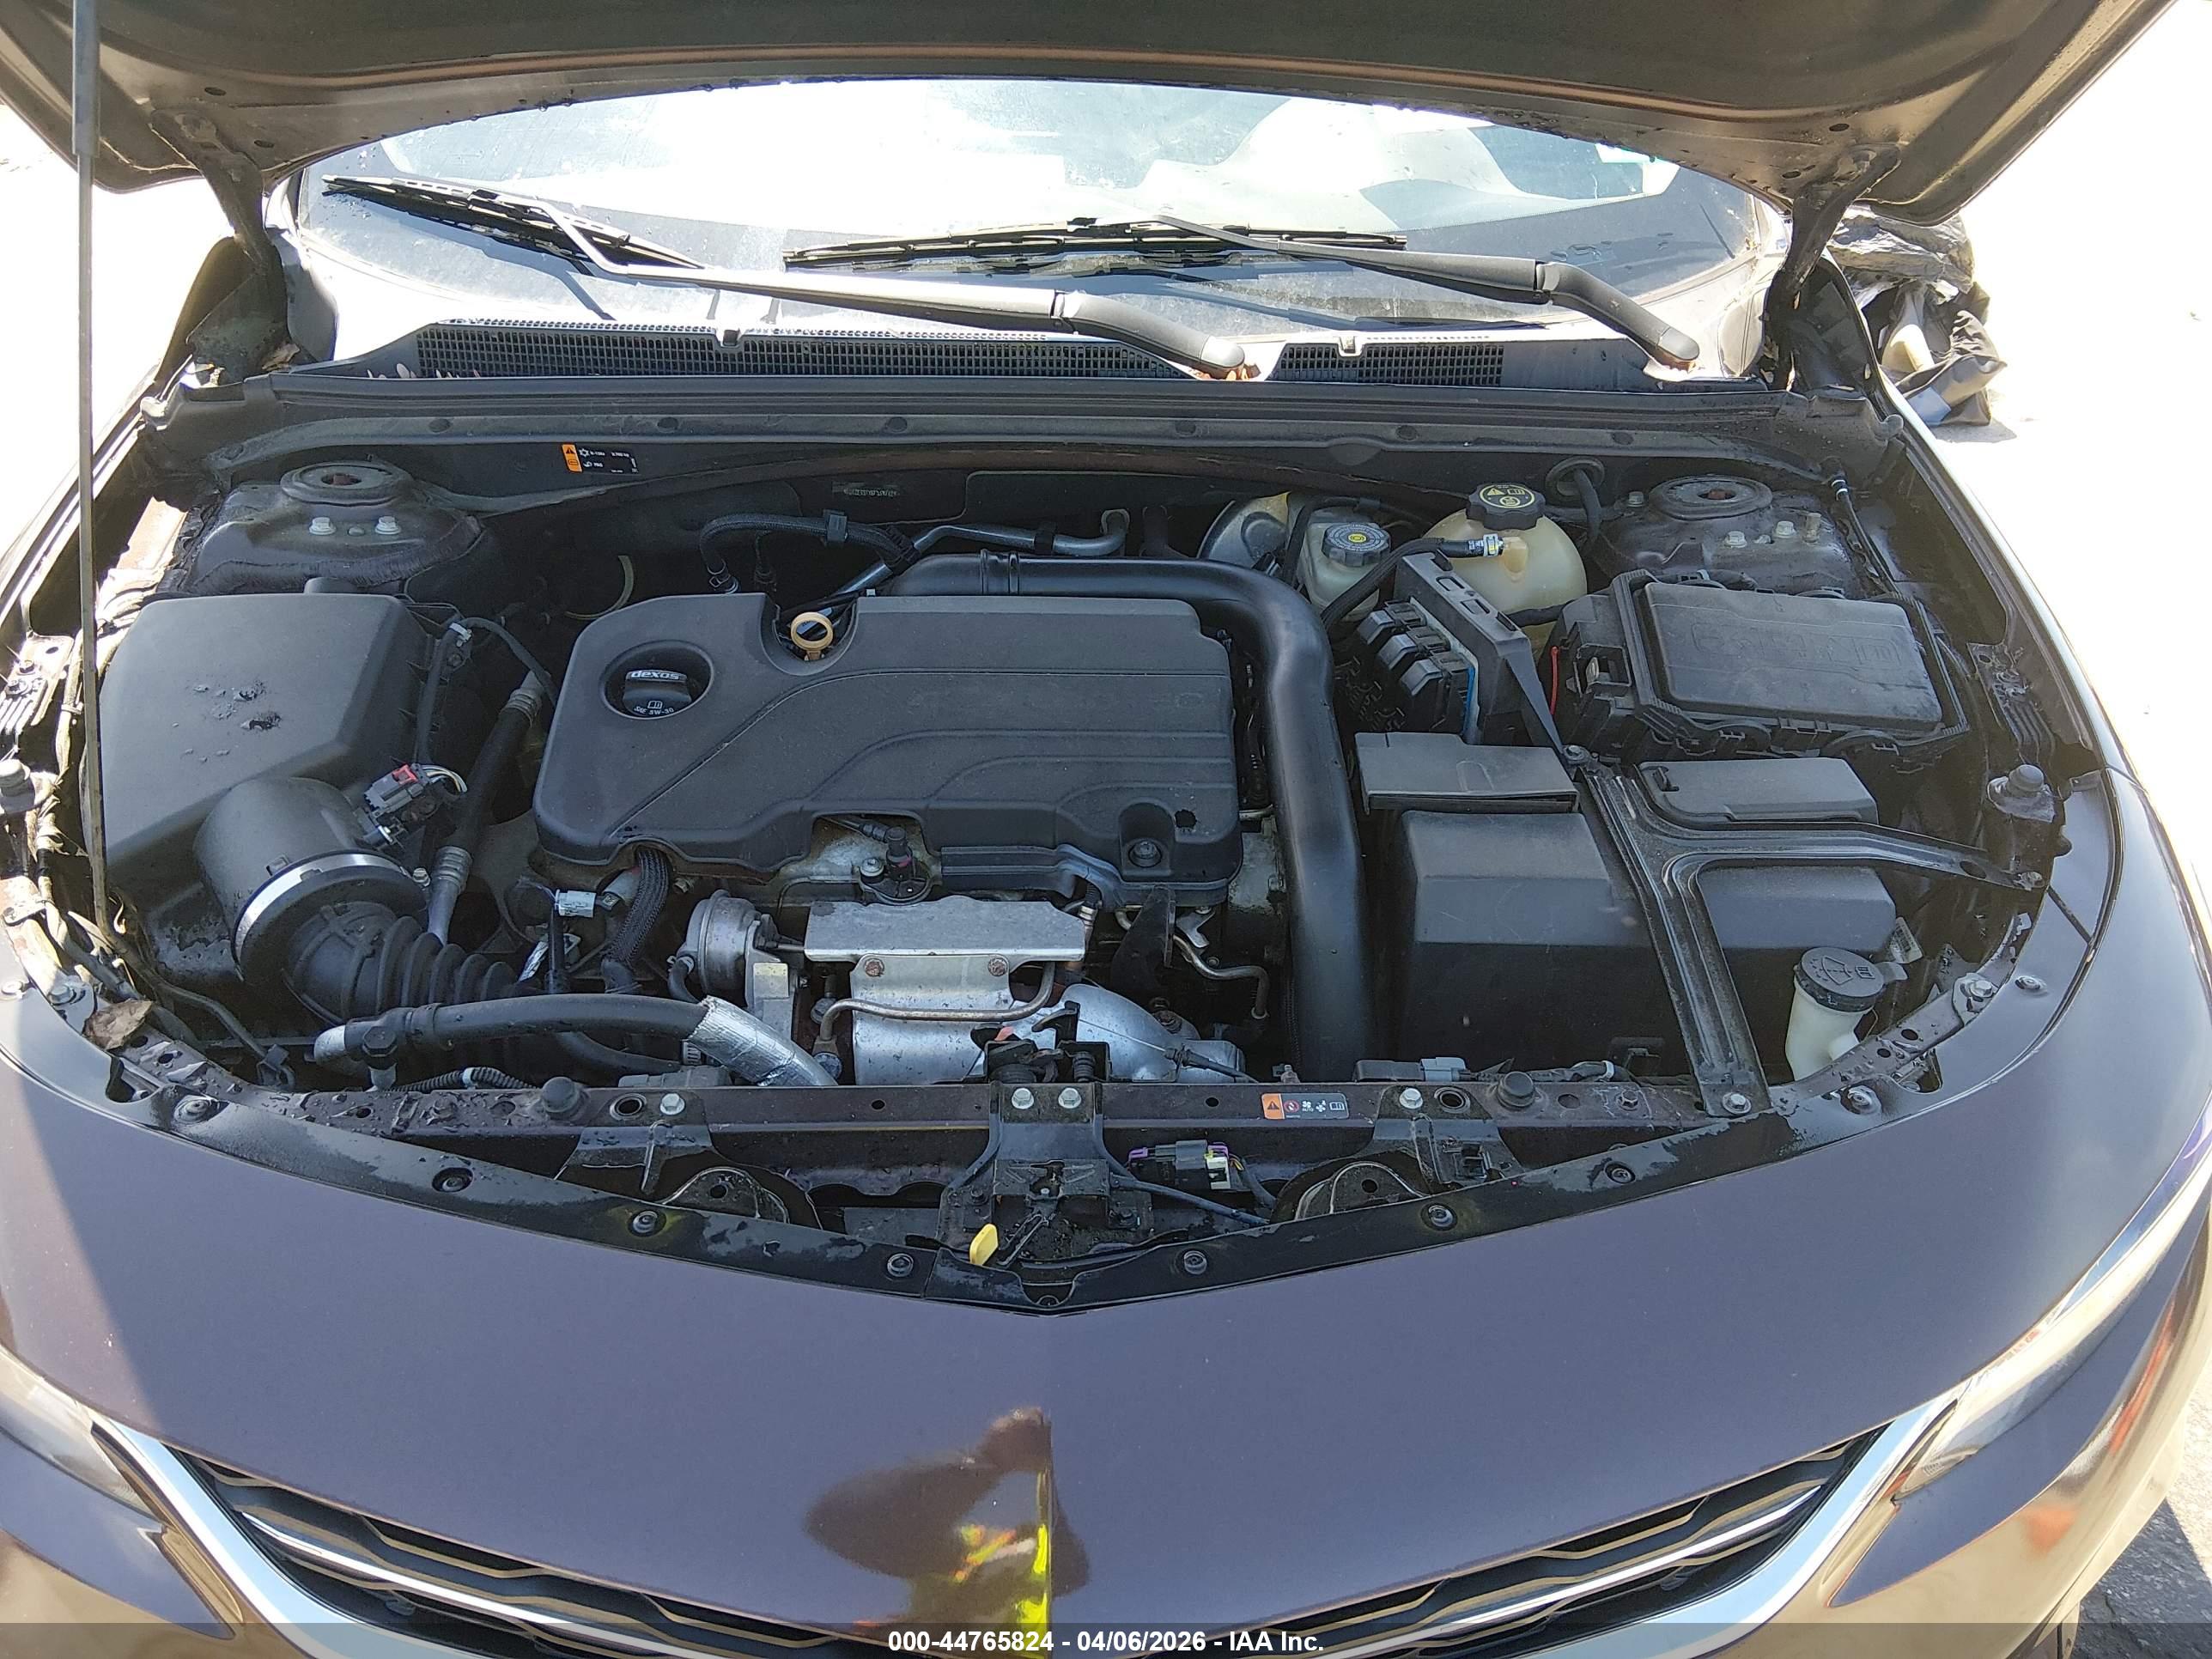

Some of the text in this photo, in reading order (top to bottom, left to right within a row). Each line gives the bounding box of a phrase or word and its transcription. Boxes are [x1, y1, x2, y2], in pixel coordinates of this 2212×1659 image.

[630, 670, 679, 680] dexos
[634, 706, 674, 715] SAE 5W-30
